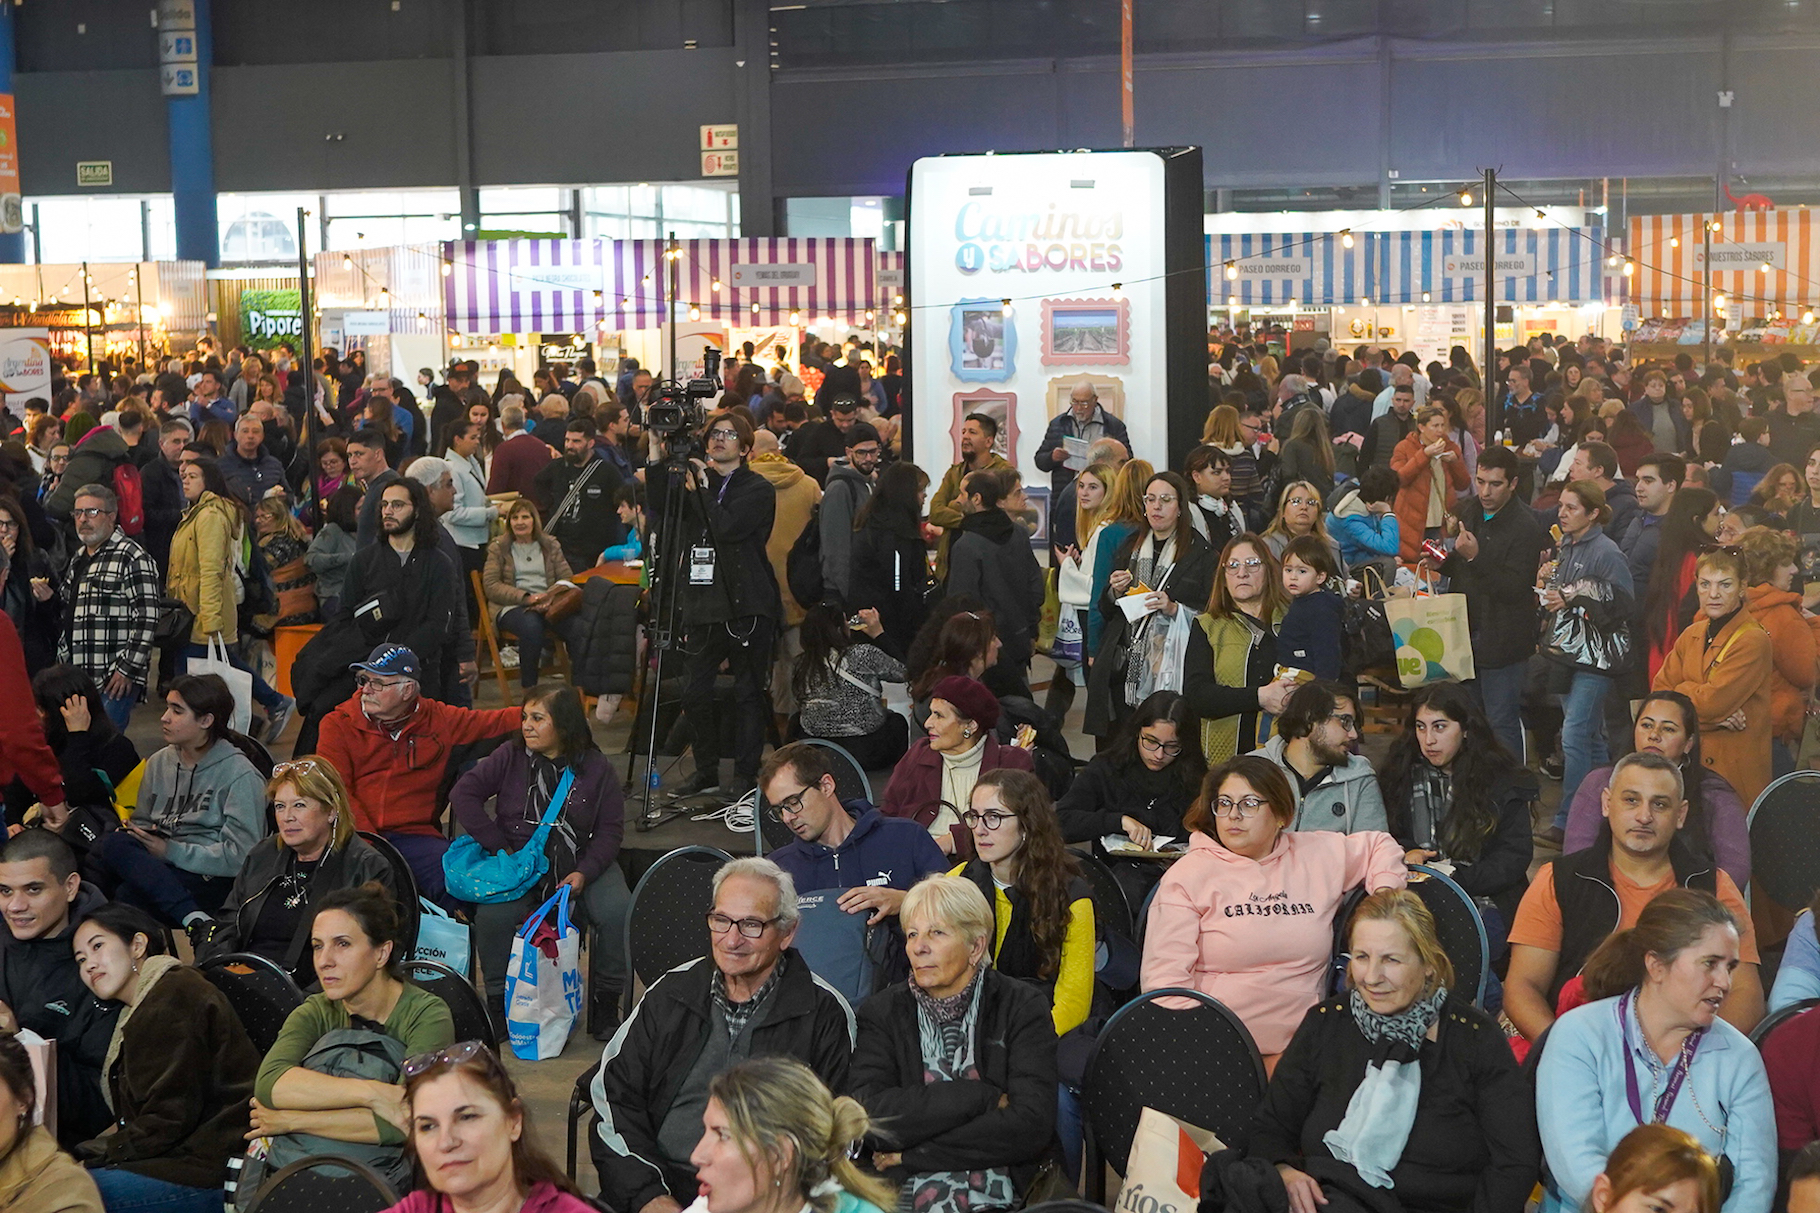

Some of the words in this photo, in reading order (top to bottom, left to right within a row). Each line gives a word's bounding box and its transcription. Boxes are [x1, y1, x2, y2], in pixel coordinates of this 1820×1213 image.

[80, 166, 108, 176] SALIDA
[955, 202, 1123, 242] Caminos
[989, 244, 1123, 273] SABORES
[1710, 252, 1742, 262] NUESTROS
[1744, 251, 1774, 261] SABORES
[1239, 265, 1263, 273] PASEO
[1265, 264, 1301, 273] DORREGO
[250, 310, 301, 339] Piporé
[866, 877, 888, 887] PUMA
[1224, 903, 1315, 917] CALIFORNIA
